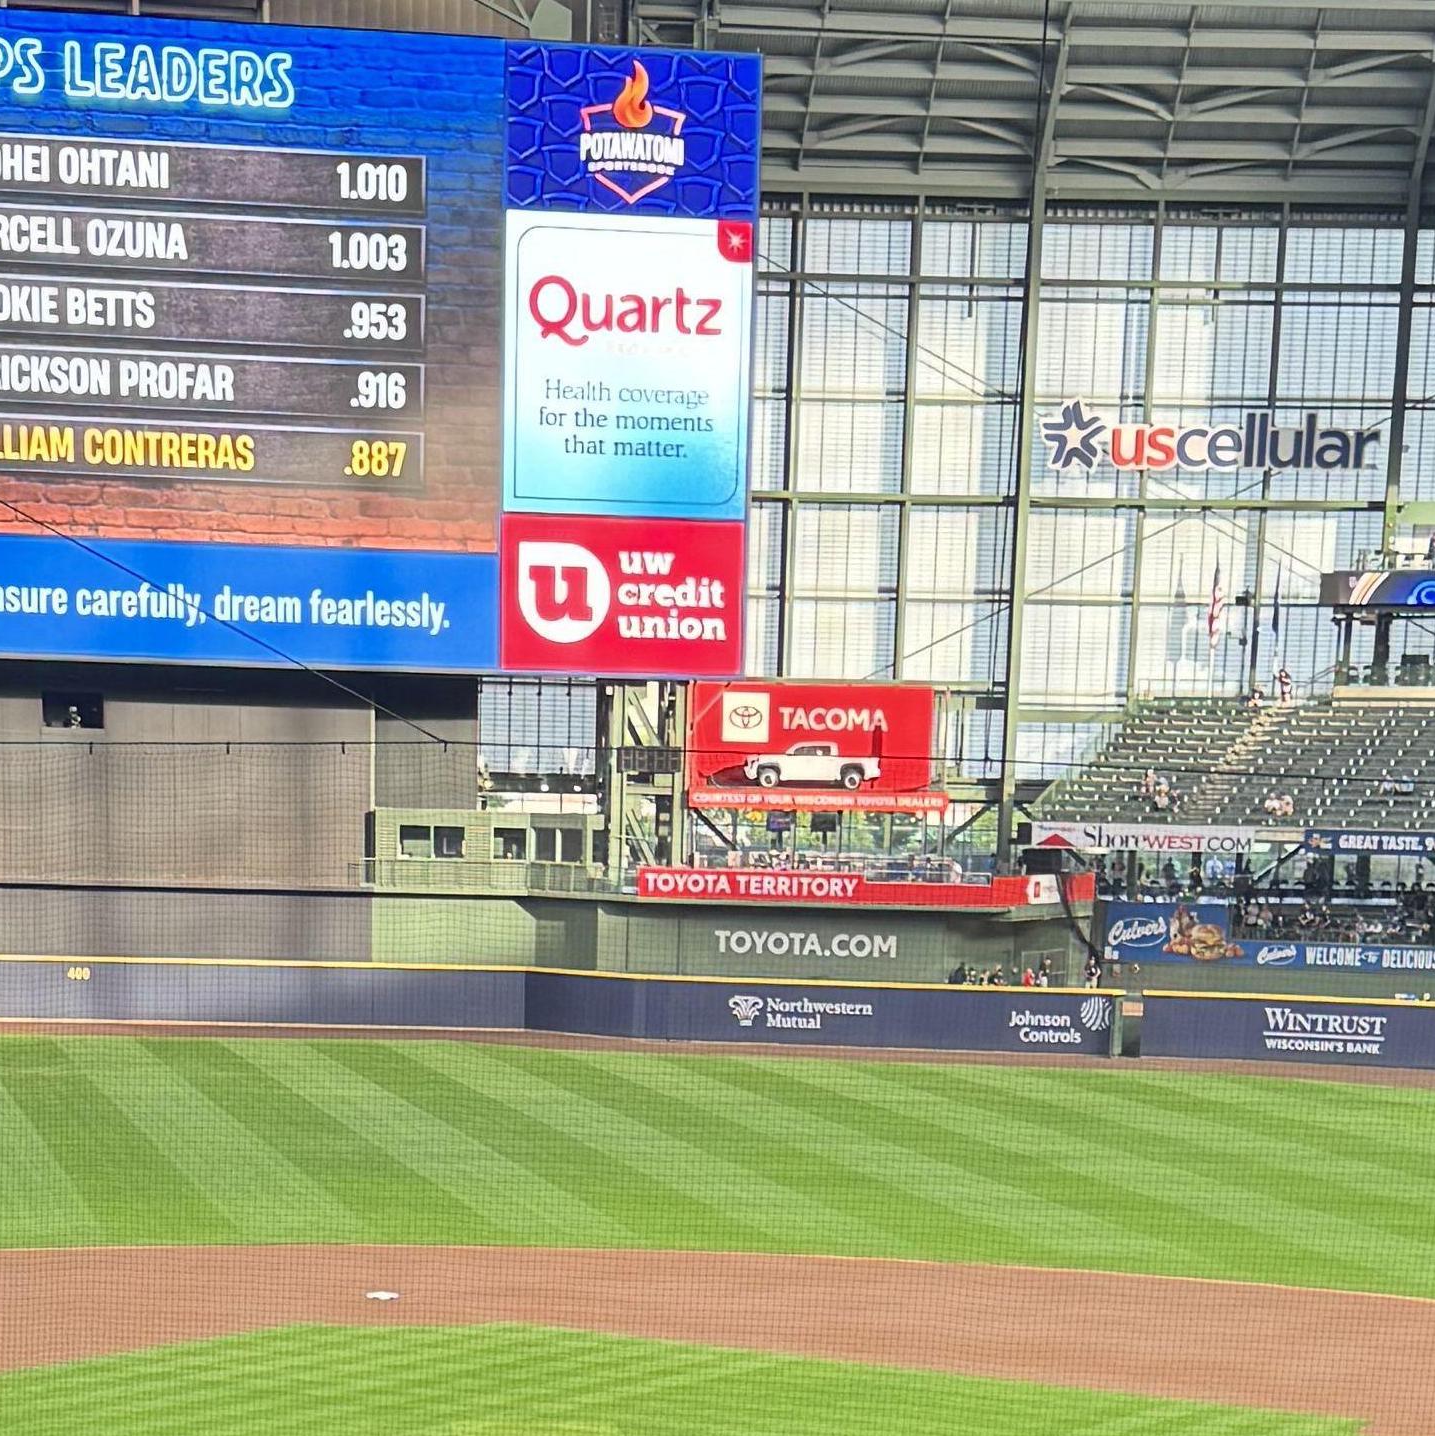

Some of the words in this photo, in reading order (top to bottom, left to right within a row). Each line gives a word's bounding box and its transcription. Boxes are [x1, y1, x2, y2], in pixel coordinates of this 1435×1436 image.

[64, 40, 295, 109] LEADERS
[580, 132, 685, 166] POTAWATOMI
[58, 146, 170, 189] OHTANI
[336, 161, 408, 202] 1.010
[87, 218, 189, 260] OZUNA
[328, 231, 408, 272] 1.003
[66, 288, 156, 329] BETTS
[342, 301, 407, 341] .953
[529, 275, 722, 346] Quartz
[119, 360, 235, 402] PROFAR
[349, 371, 407, 410] .916
[545, 378, 611, 402] Health
[618, 386, 709, 410] coverage
[539, 406, 565, 427] for
[574, 407, 608, 429] the
[616, 413, 714, 432] moments
[83, 427, 255, 472] CONTRERAS
[343, 440, 407, 478] .887
[564, 434, 606, 455] that
[613, 439, 687, 459] matter.
[618, 551, 675, 575] uw
[617, 577, 725, 609] credit
[76, 583, 206, 628] carefully,
[215, 585, 300, 624] dream
[309, 589, 451, 637] fearlessly.
[617, 609, 727, 641] union
[778, 705, 889, 732] TACOMA
[1339, 834, 1379, 850] GREAT
[645, 873, 731, 894] TOYOTA
[736, 875, 859, 897] TERRITORY
[715, 930, 897, 958] TOYOTA.COM
[1306, 945, 1361, 966] WELCOME
[767, 998, 873, 1016] Northwestern
[1009, 1011, 1071, 1028] Johnson
[767, 1013, 822, 1030] Mutual
[1265, 1008, 1387, 1034] WINTRUST
[1019, 1029, 1082, 1044] Controls
[1347, 1041, 1380, 1054] BANK
